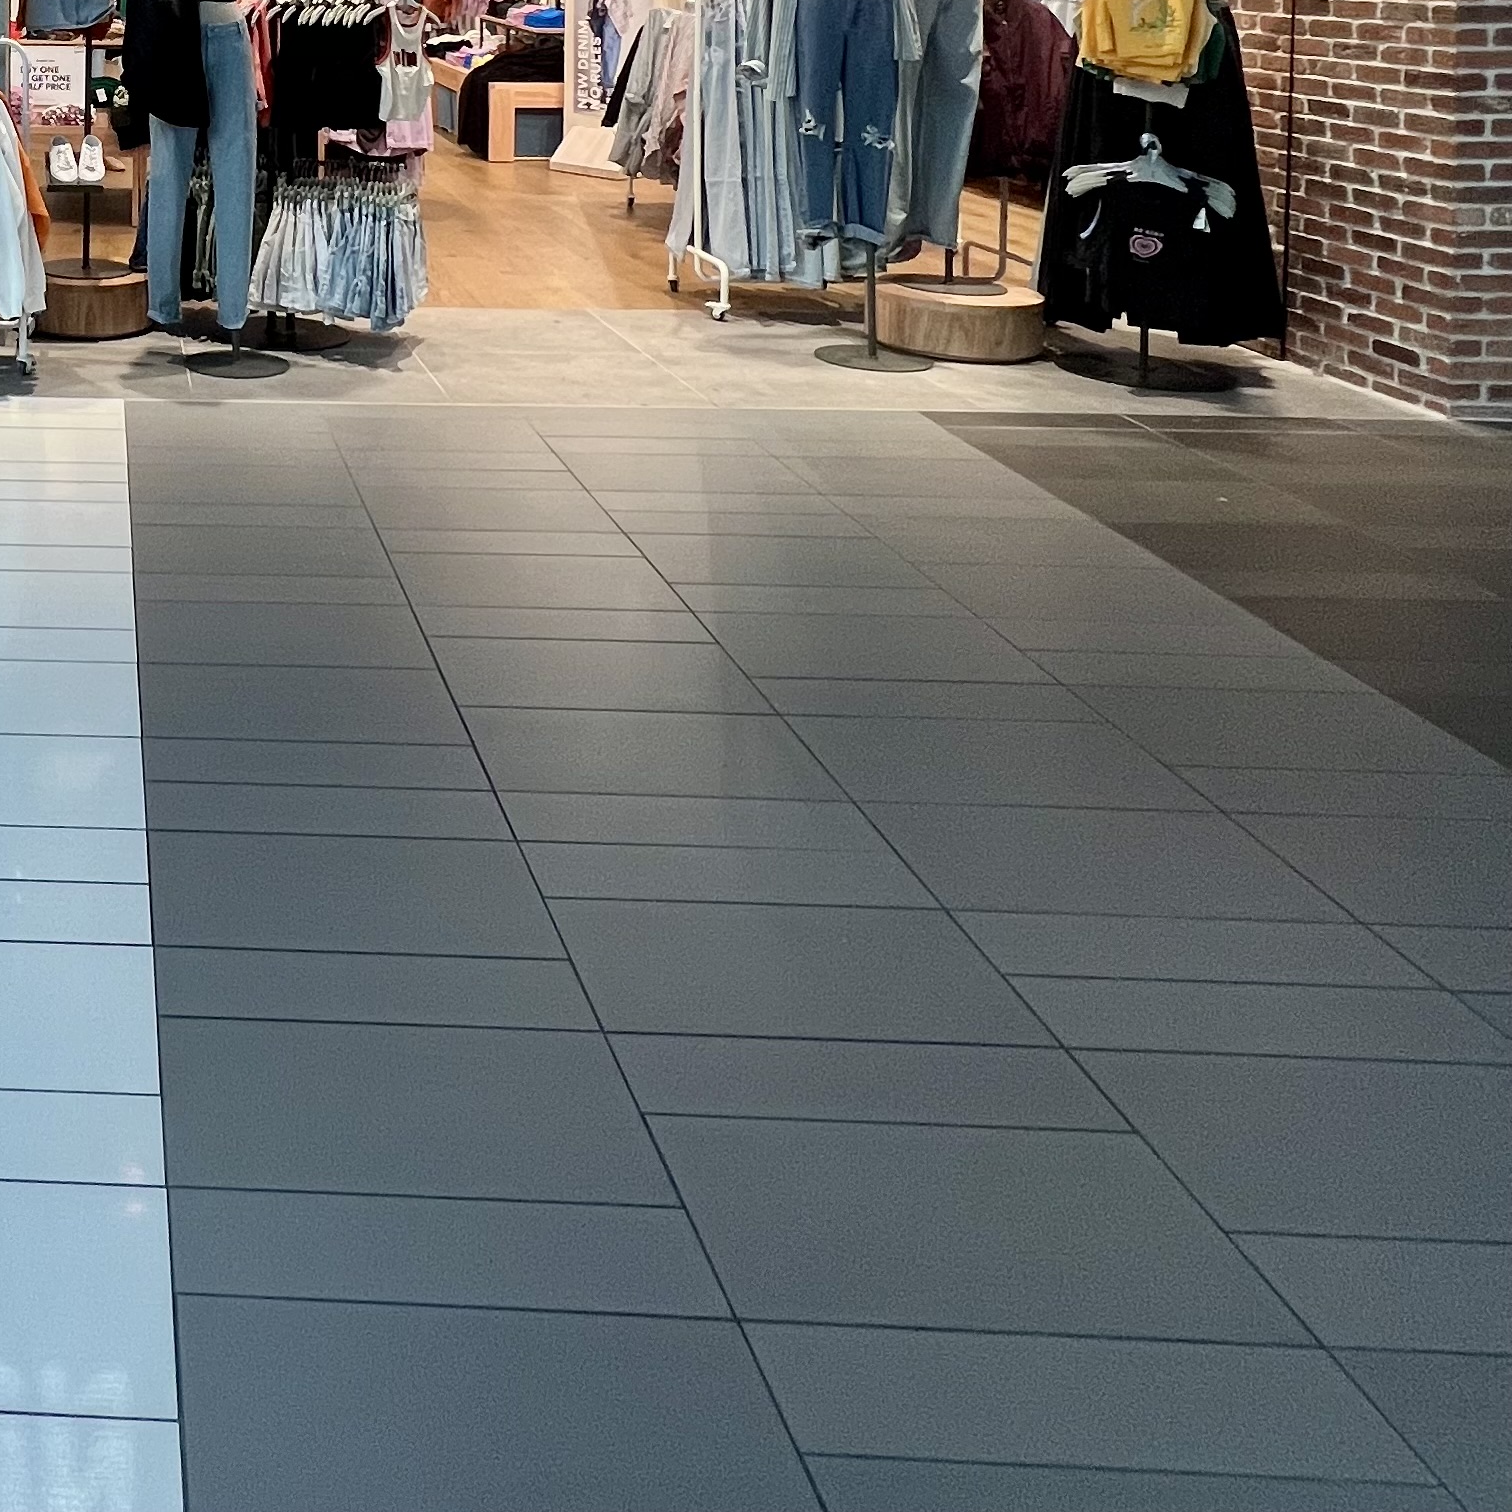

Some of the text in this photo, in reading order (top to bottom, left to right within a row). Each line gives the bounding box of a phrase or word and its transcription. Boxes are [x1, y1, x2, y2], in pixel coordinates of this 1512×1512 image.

[31, 74, 71, 82] GET ONE
[39, 66, 59, 74] ONE
[589, 36, 602, 110] NO RULES
[577, 73, 589, 109] NEW
